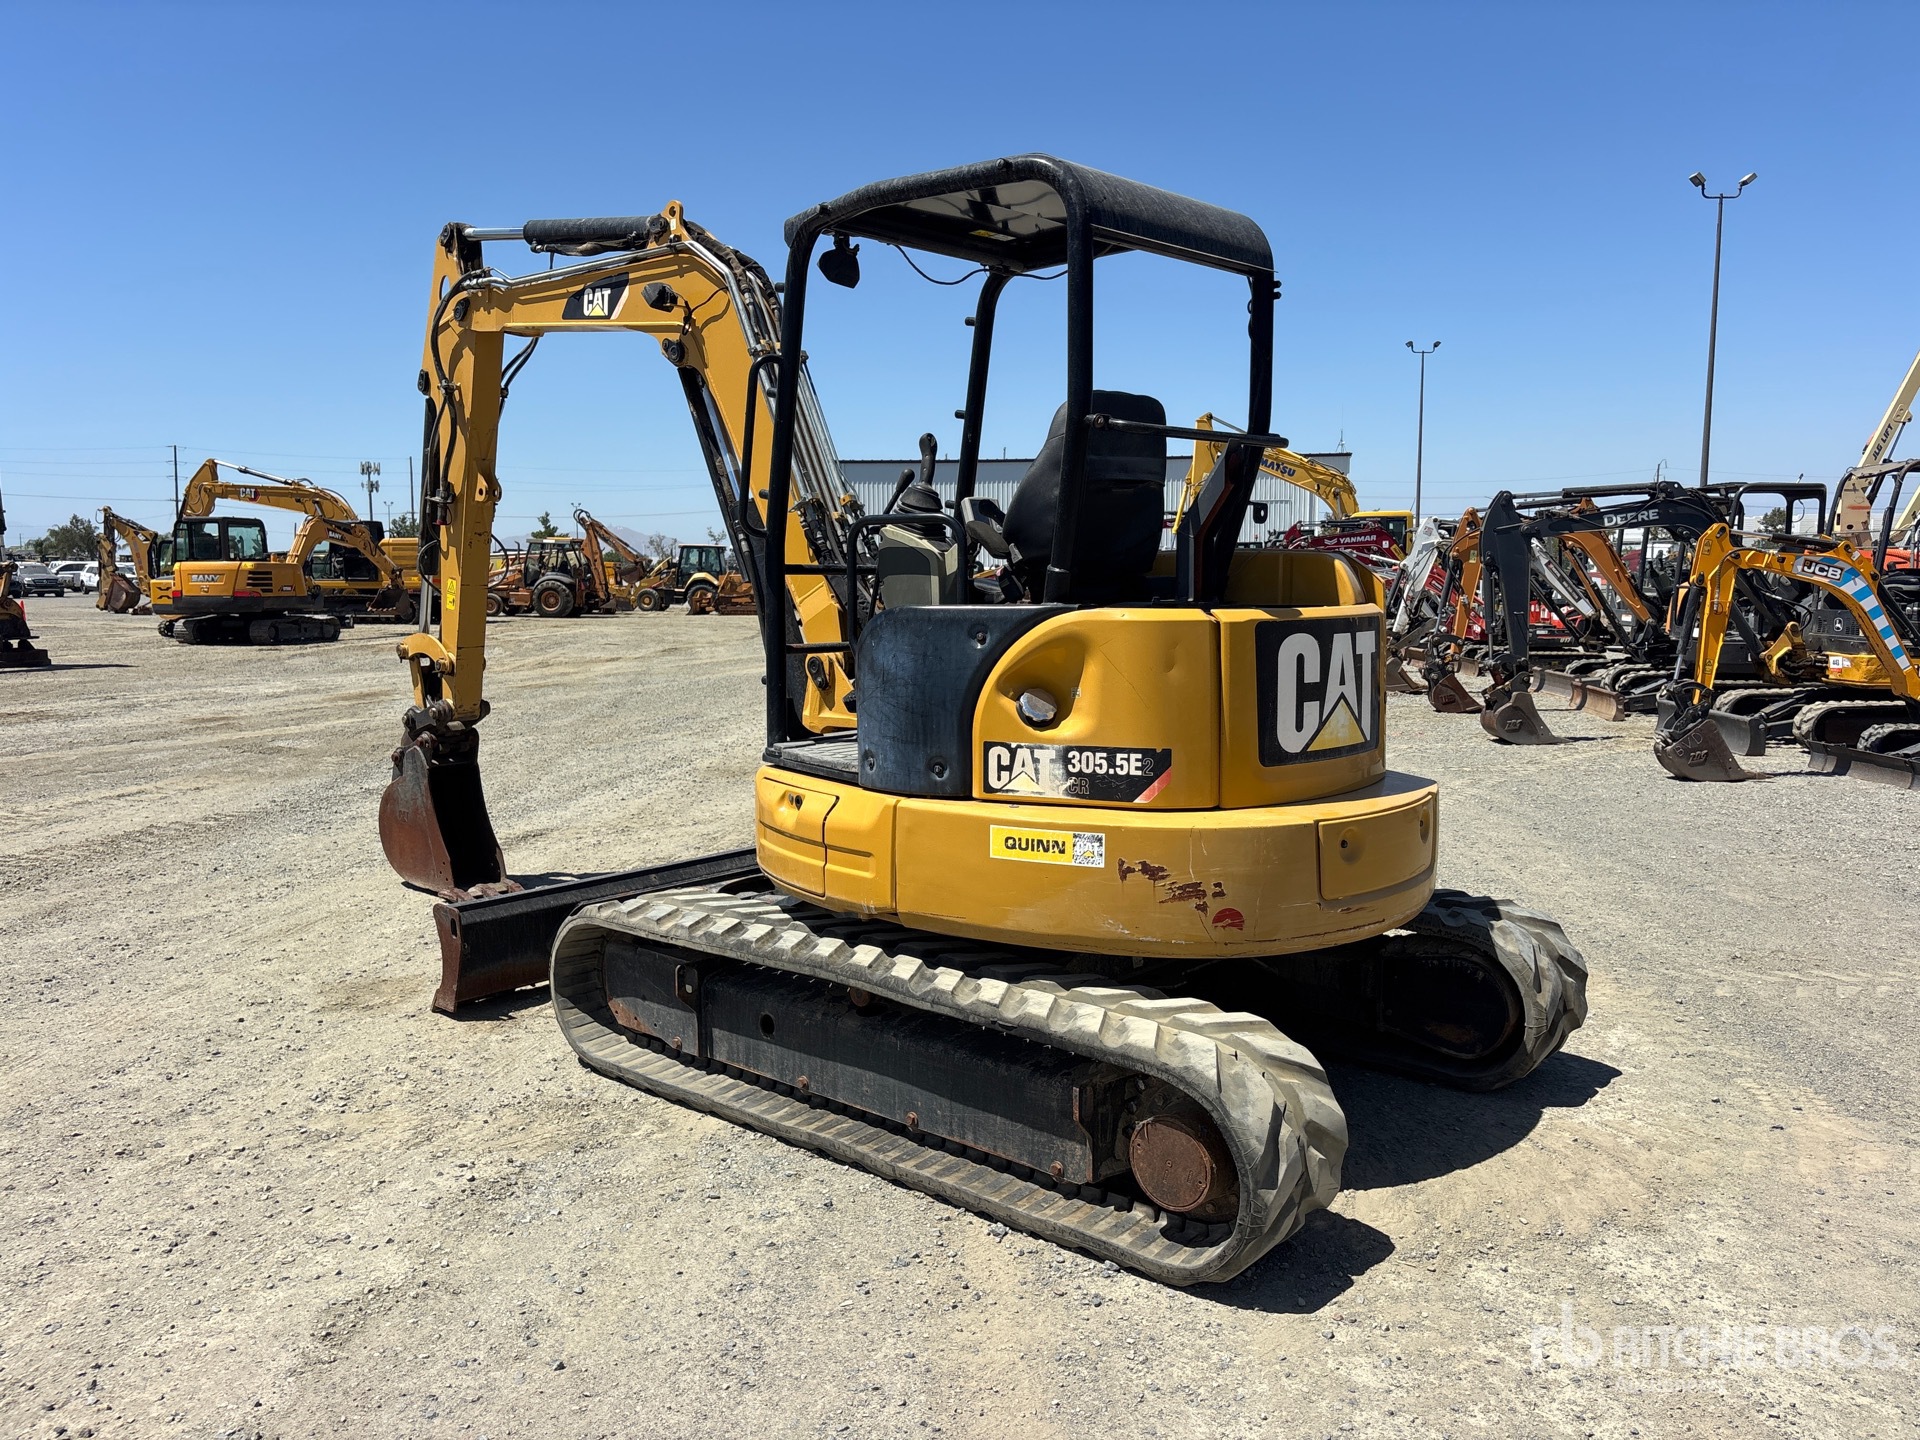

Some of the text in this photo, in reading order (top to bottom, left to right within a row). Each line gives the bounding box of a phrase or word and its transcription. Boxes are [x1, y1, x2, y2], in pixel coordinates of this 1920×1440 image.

[583, 287, 611, 317] CAT
[1872, 422, 1893, 461] JLG LIFT
[1260, 458, 1296, 477] MATSU
[240, 488, 256, 499] CAT
[1603, 509, 1660, 527] DEERE
[1339, 535, 1377, 544] YANMAR
[191, 575, 220, 583] SANY
[1803, 562, 1842, 580] JCB
[1276, 630, 1376, 754] CAT
[988, 746, 1154, 796] CAT 305.5E2
[1067, 777, 1090, 795] CR
[1004, 836, 1066, 854] QUINN
